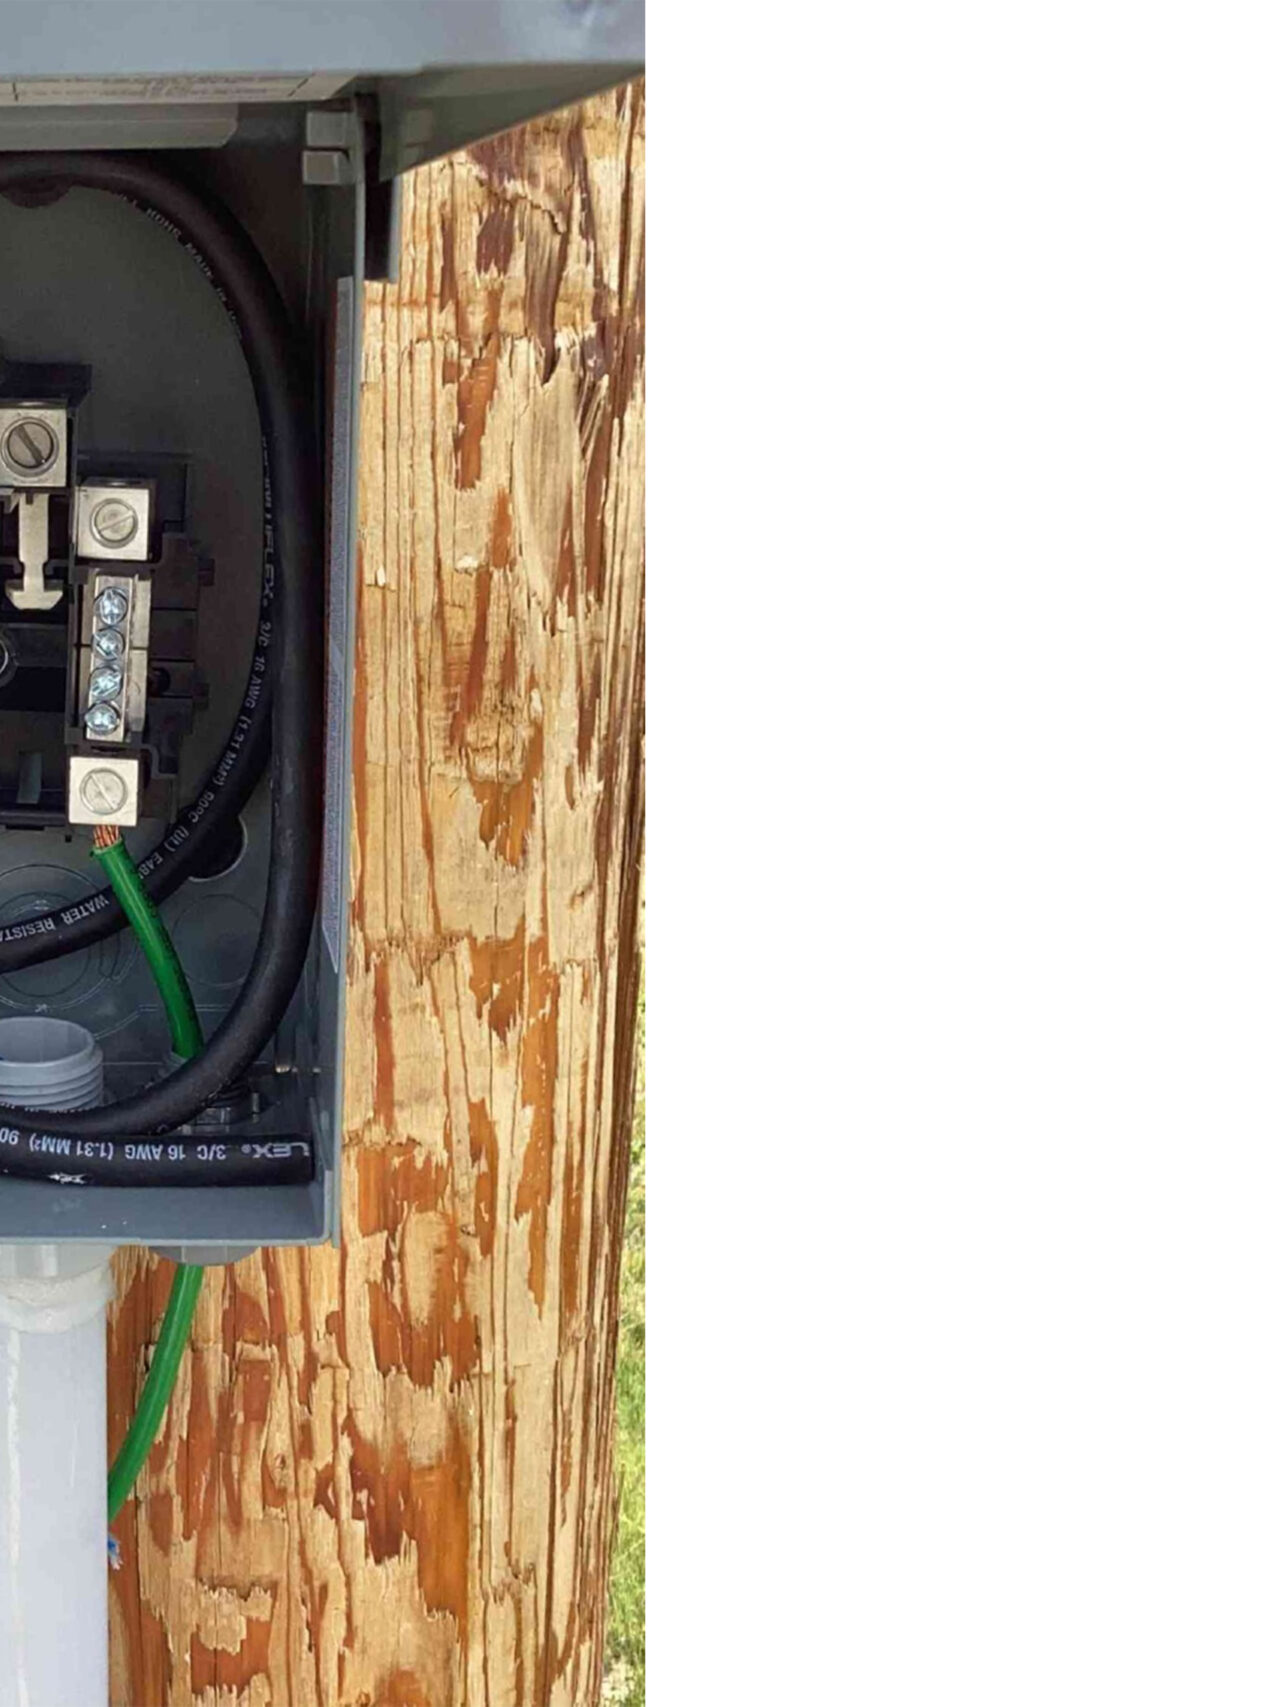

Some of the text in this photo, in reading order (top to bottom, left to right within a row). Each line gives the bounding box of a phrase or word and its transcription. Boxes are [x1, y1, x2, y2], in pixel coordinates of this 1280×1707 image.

[254, 655, 266, 673] 16
[243, 676, 262, 709] AWG
[164, 825, 190, 852] (UL)
[61, 893, 110, 926] WATER
[75, 1142, 115, 1161] (1.31
[124, 1144, 163, 1161] AWG
[167, 1144, 187, 1161] 16
[196, 1144, 228, 1161] 3/C
